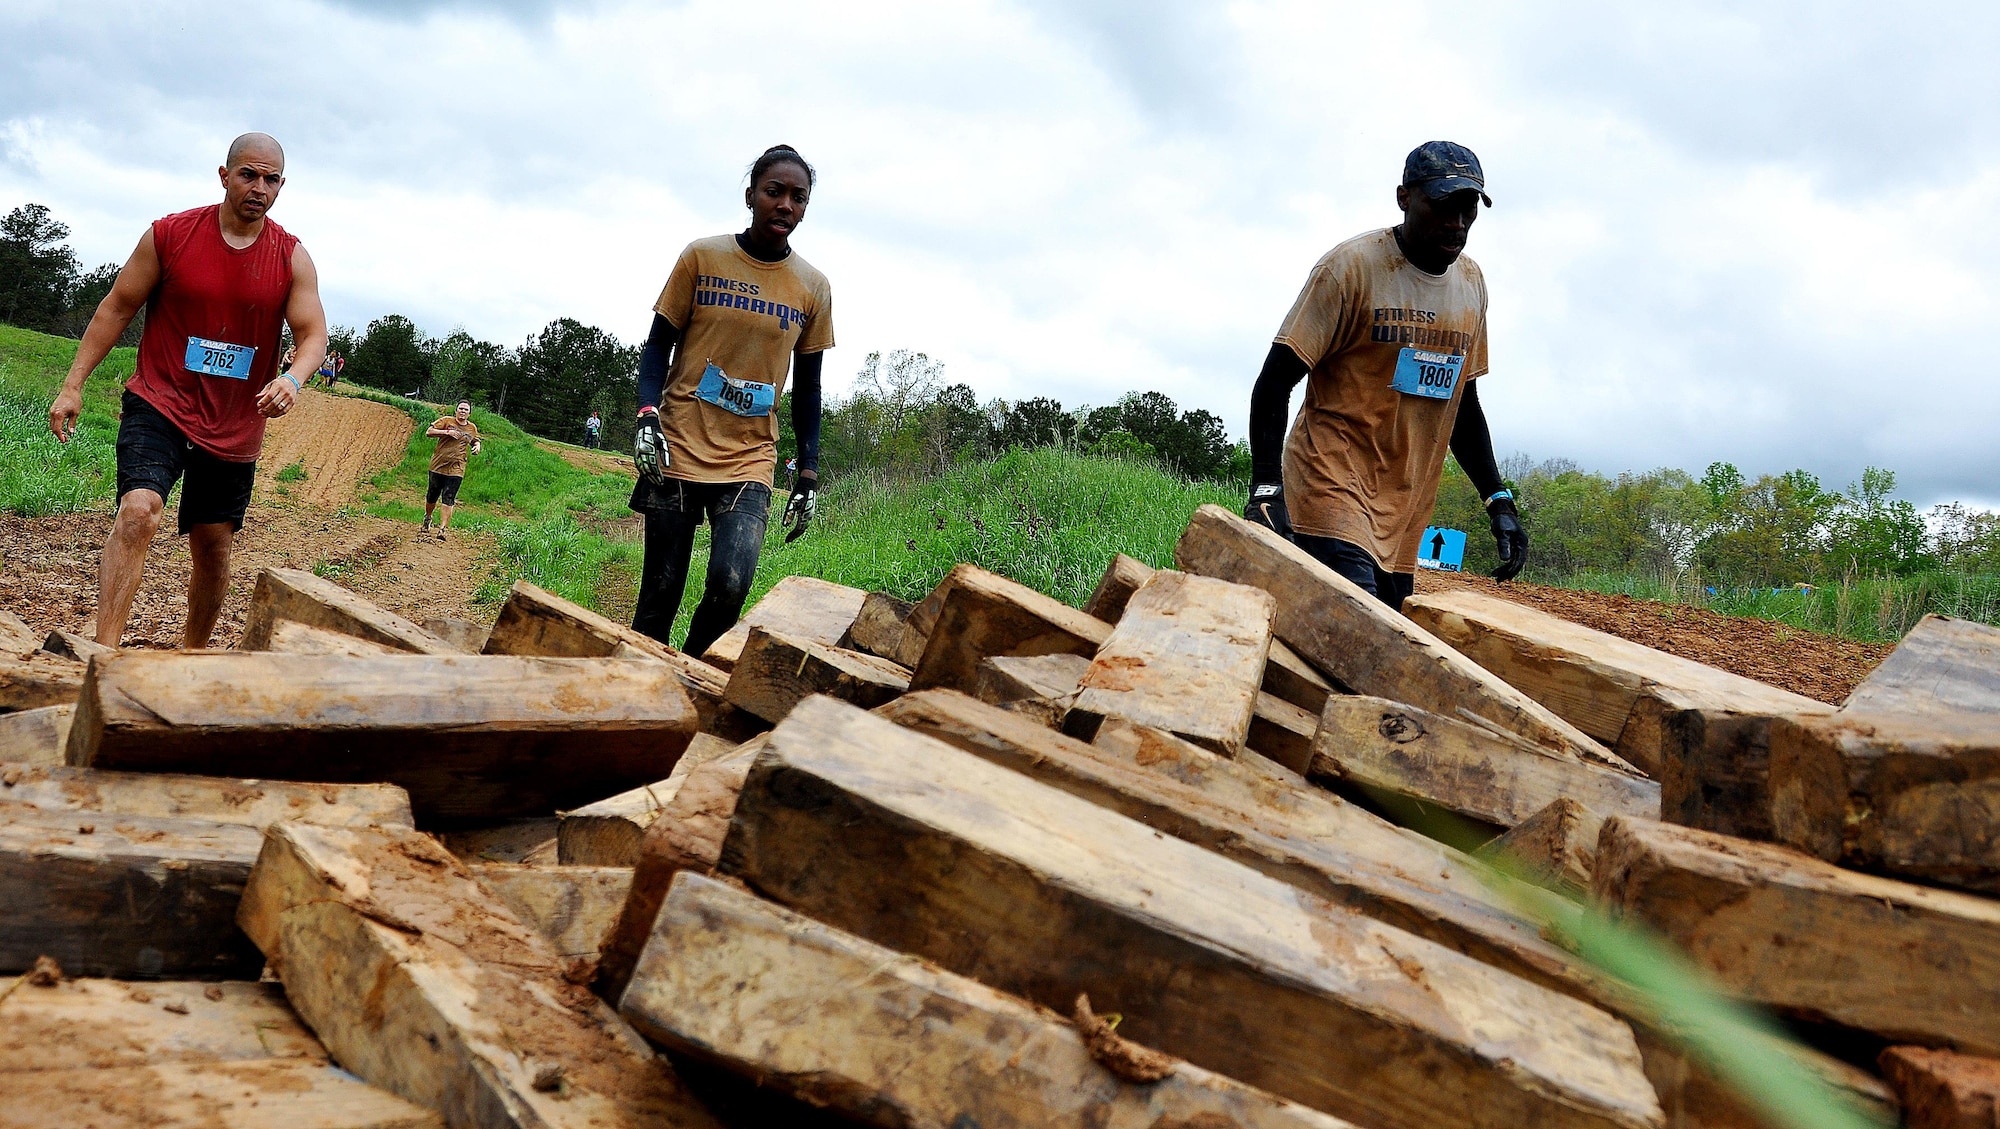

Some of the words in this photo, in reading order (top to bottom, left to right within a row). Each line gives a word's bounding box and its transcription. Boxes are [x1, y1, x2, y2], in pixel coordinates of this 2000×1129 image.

[697, 275, 760, 296] FITNESS
[697, 290, 809, 330] WARRIORS
[1374, 308, 1436, 325] FITNESS
[1371, 325, 1471, 350] WARRIOR
[203, 350, 235, 370] 2762
[1418, 364, 1454, 389] 1808
